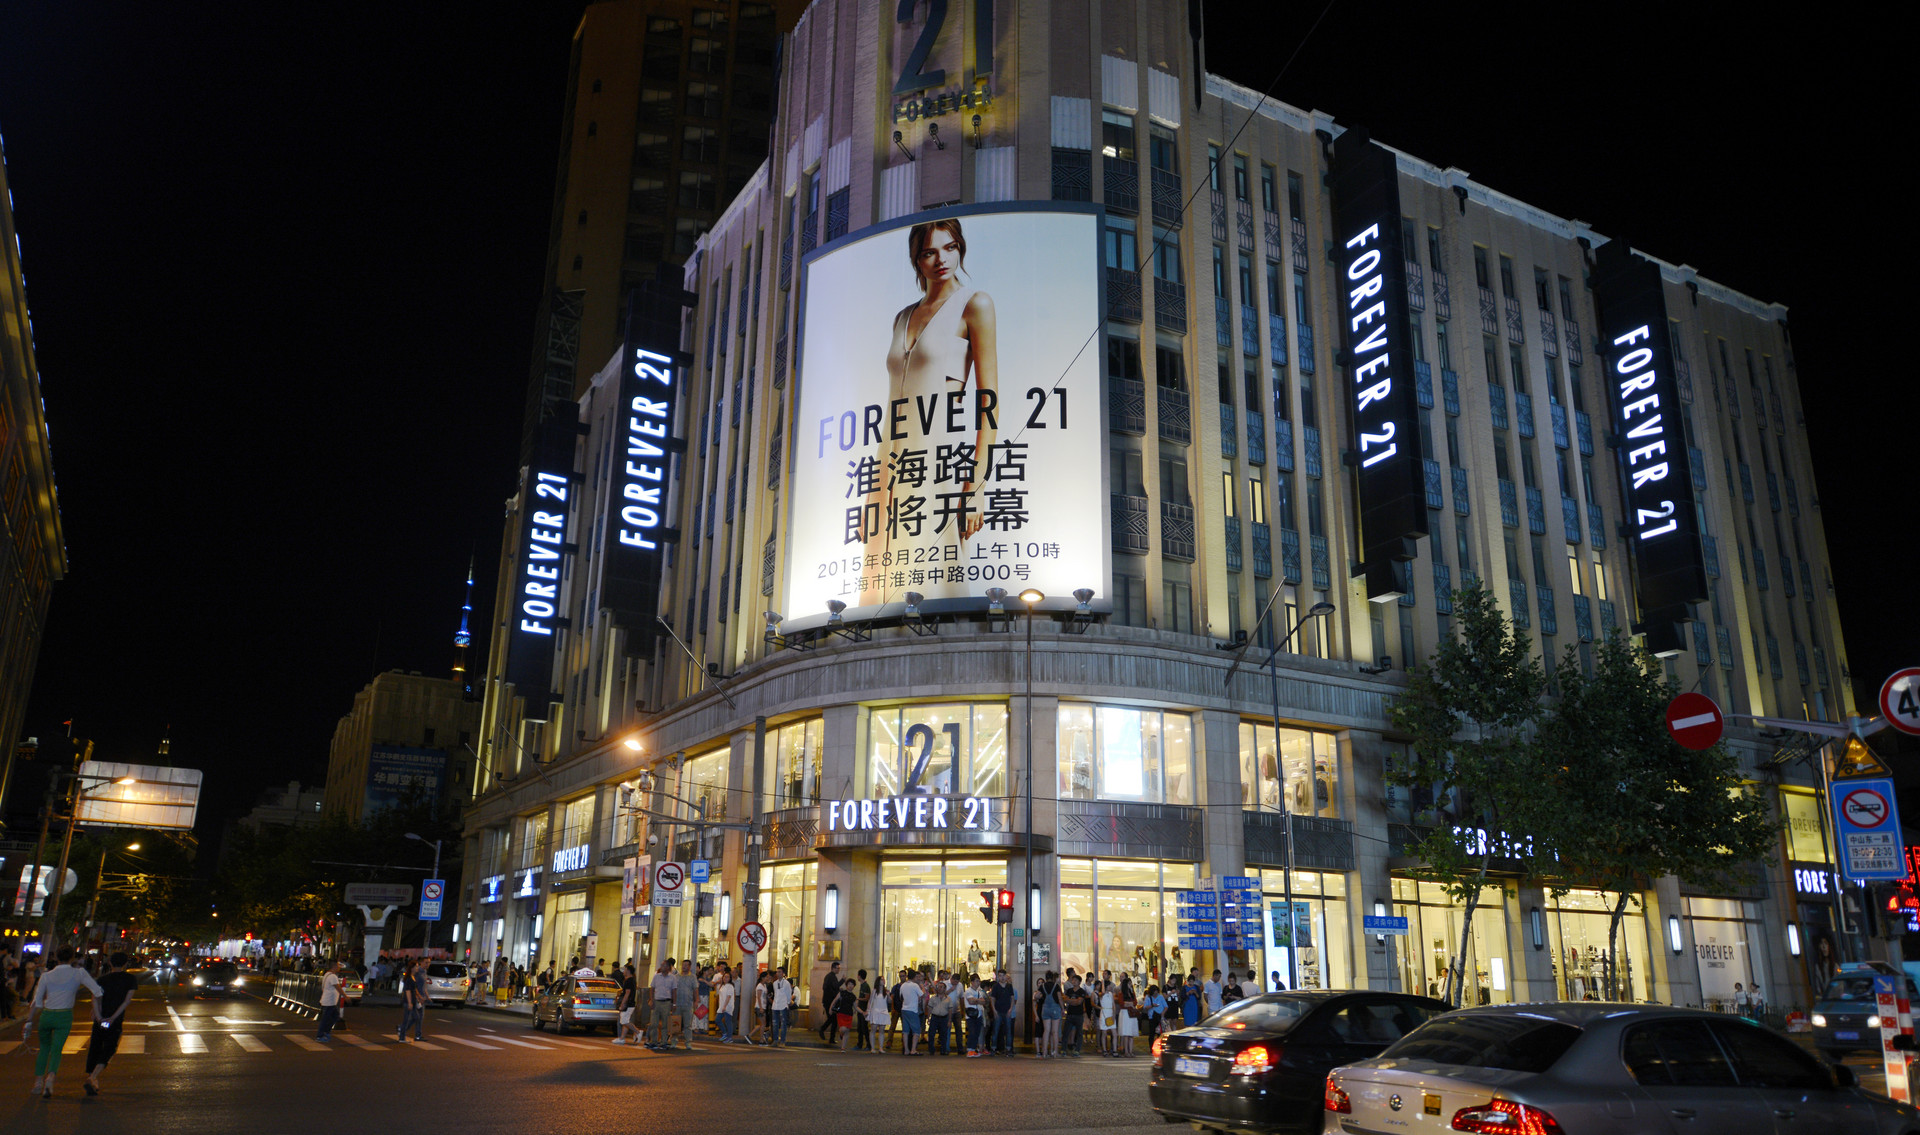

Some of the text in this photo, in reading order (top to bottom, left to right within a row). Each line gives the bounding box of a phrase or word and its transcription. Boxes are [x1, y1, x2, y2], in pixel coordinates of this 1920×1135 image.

[892, 0, 993, 95] 21
[893, 84, 993, 124] FOREVER
[1346, 222, 1397, 468] FOREVER 21
[619, 348, 672, 550] FOREVER 21
[818, 386, 1068, 459] FOREVER 21
[1613, 324, 1677, 540] FOREVER 21
[845, 439, 1029, 500] 淮海路店
[843, 488, 1030, 546] 即将开幕
[520, 472, 568, 635] FOREVER 21
[817, 542, 1061, 579] 2015年8月22日 上午10時
[837, 563, 1031, 596] 上海市淮海中路900号
[1898, 684, 1920, 720] 4
[902, 723, 960, 794] 21
[829, 797, 991, 831] FOREVER 21
[553, 846, 580, 873] FOREVER
